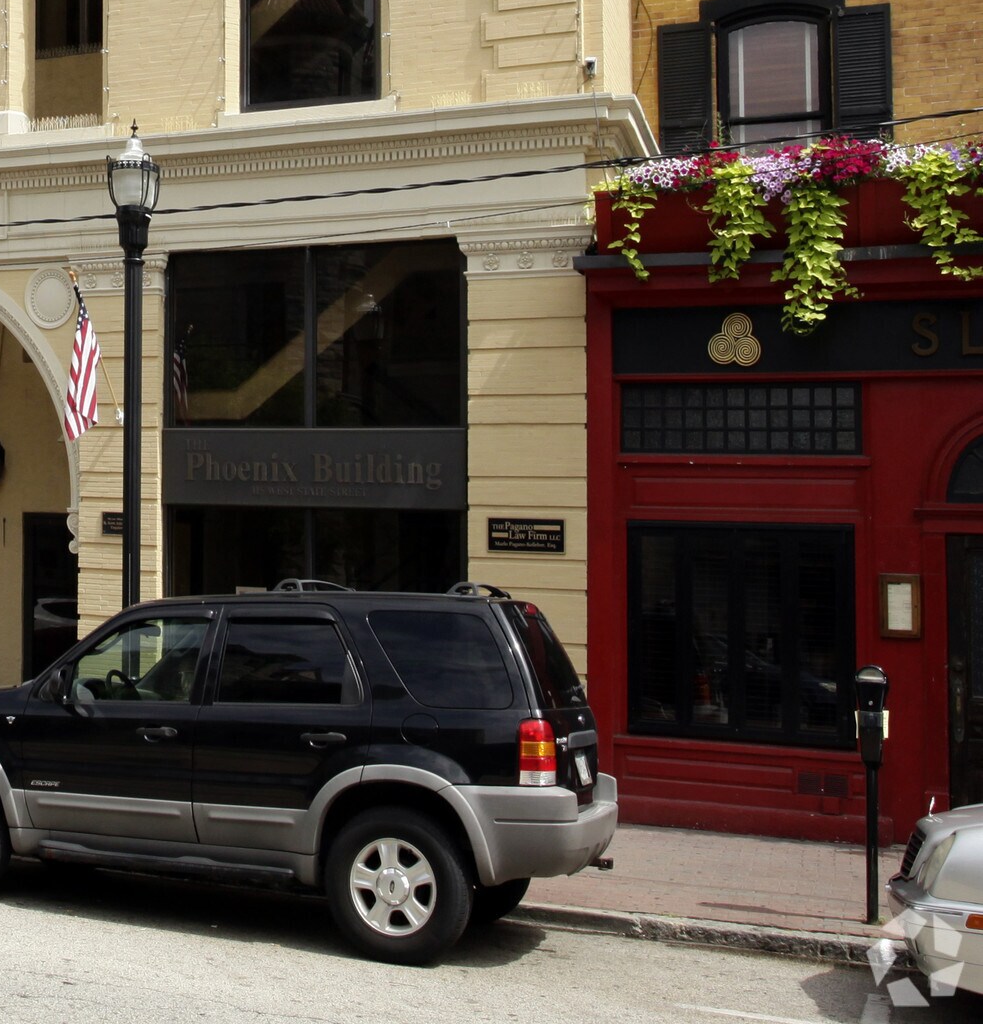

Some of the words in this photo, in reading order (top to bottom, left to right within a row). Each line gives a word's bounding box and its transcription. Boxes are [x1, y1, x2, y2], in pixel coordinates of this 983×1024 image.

[184, 452, 298, 483] Phoenix
[311, 452, 443, 491] Building
[268, 487, 295, 497] WEST
[297, 487, 326, 497] STATE
[328, 487, 368, 497] STREET
[504, 521, 533, 532] Pagano
[509, 530, 527, 540] Law
[528, 530, 548, 540] Firm
[30, 779, 61, 787] ESCAPE
